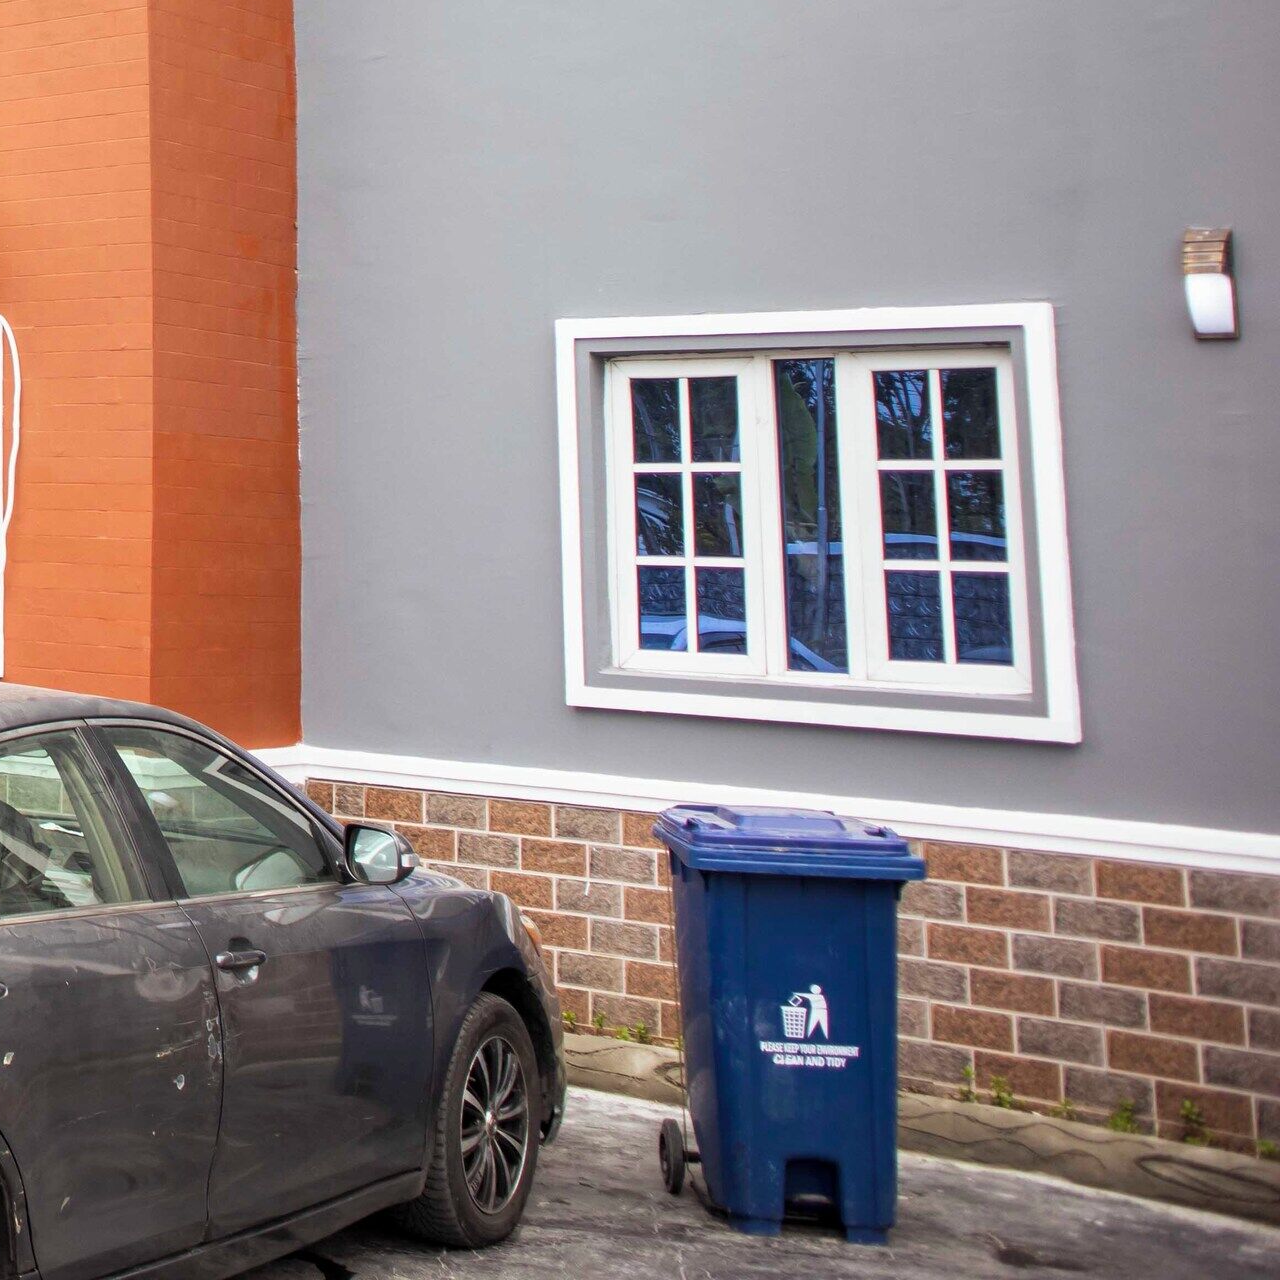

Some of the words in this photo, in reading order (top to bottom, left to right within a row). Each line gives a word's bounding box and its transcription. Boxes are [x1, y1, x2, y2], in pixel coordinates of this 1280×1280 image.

[759, 1041, 783, 1053] PLEASE
[784, 1043, 799, 1054] KEEP
[799, 1043, 816, 1055] YOUR
[817, 1044, 859, 1057] ENVIRONMENT
[773, 1054, 804, 1066] CLEAN
[805, 1056, 825, 1067] AND
[826, 1057, 846, 1068] TIDY
